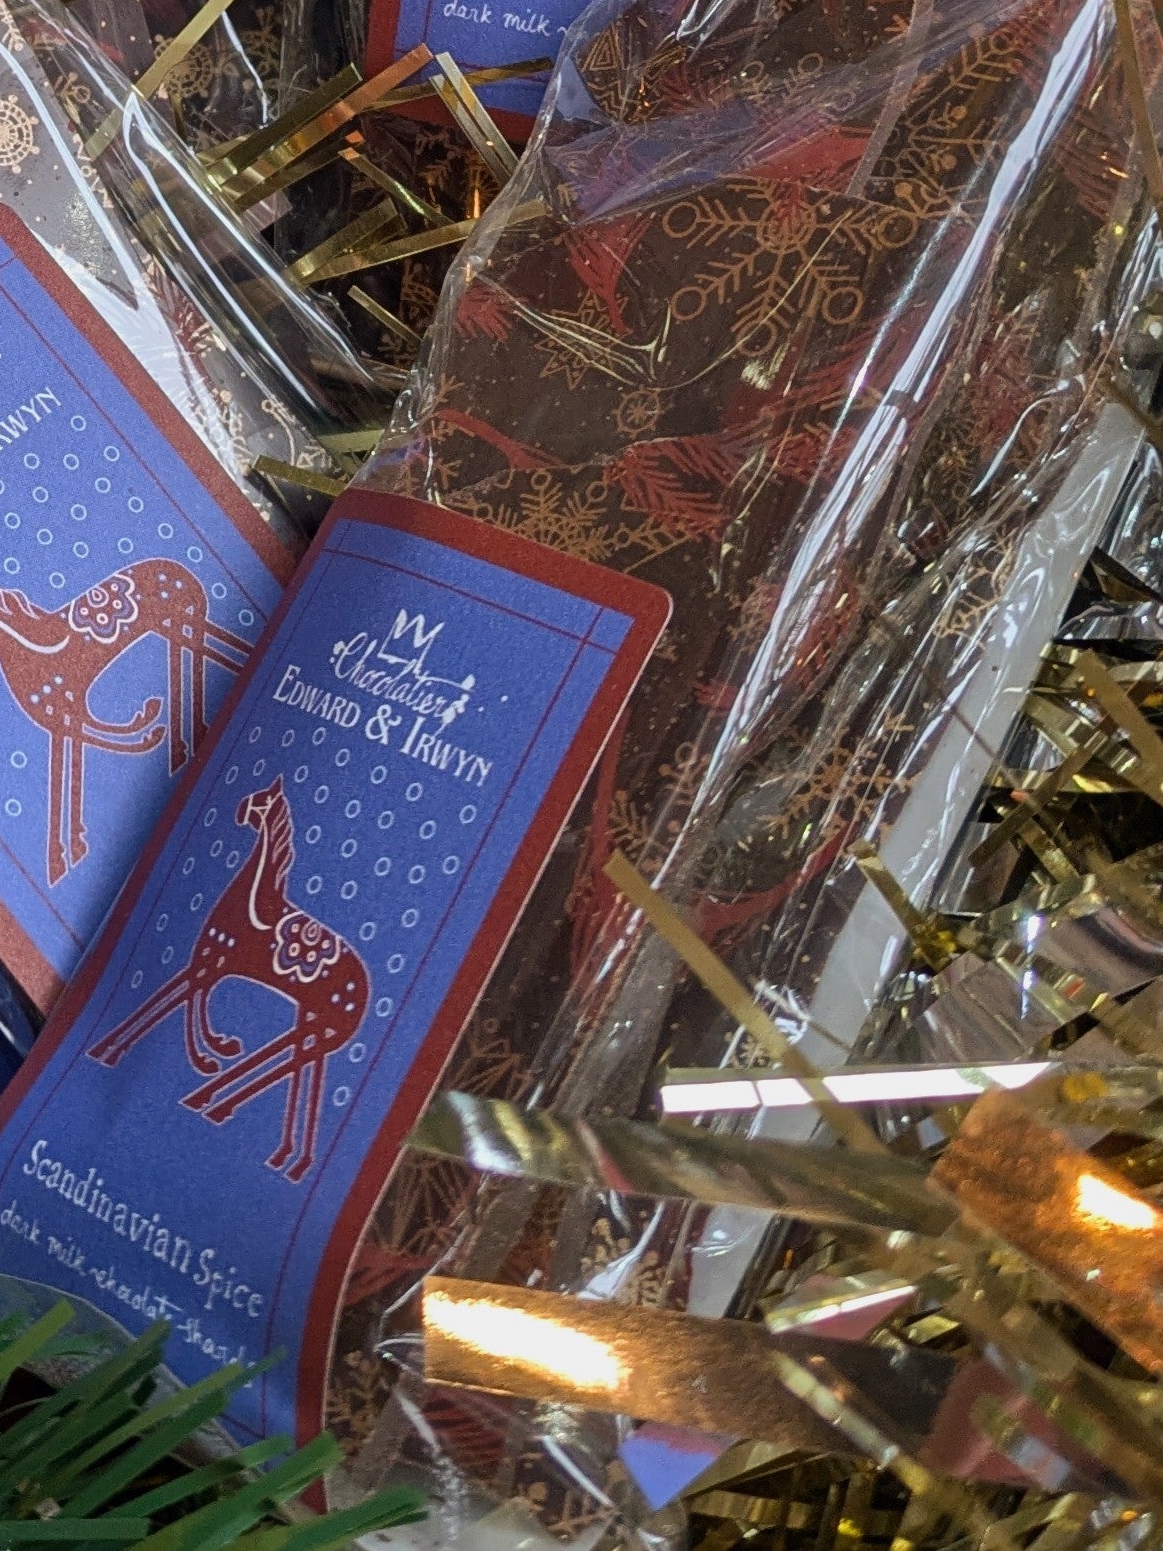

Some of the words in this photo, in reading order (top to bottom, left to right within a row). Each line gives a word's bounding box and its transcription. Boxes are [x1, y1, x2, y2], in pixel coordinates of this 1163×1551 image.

[503, 7, 551, 37] milk
[272, 663, 362, 729] EDWARD
[364, 703, 403, 746] &
[398, 715, 493, 787] IRWYN
[0, 1199, 41, 1245] dark
[46, 1235, 86, 1276] milk
[22, 1138, 192, 1274] Scandinavian
[192, 1247, 263, 1318] Spice
